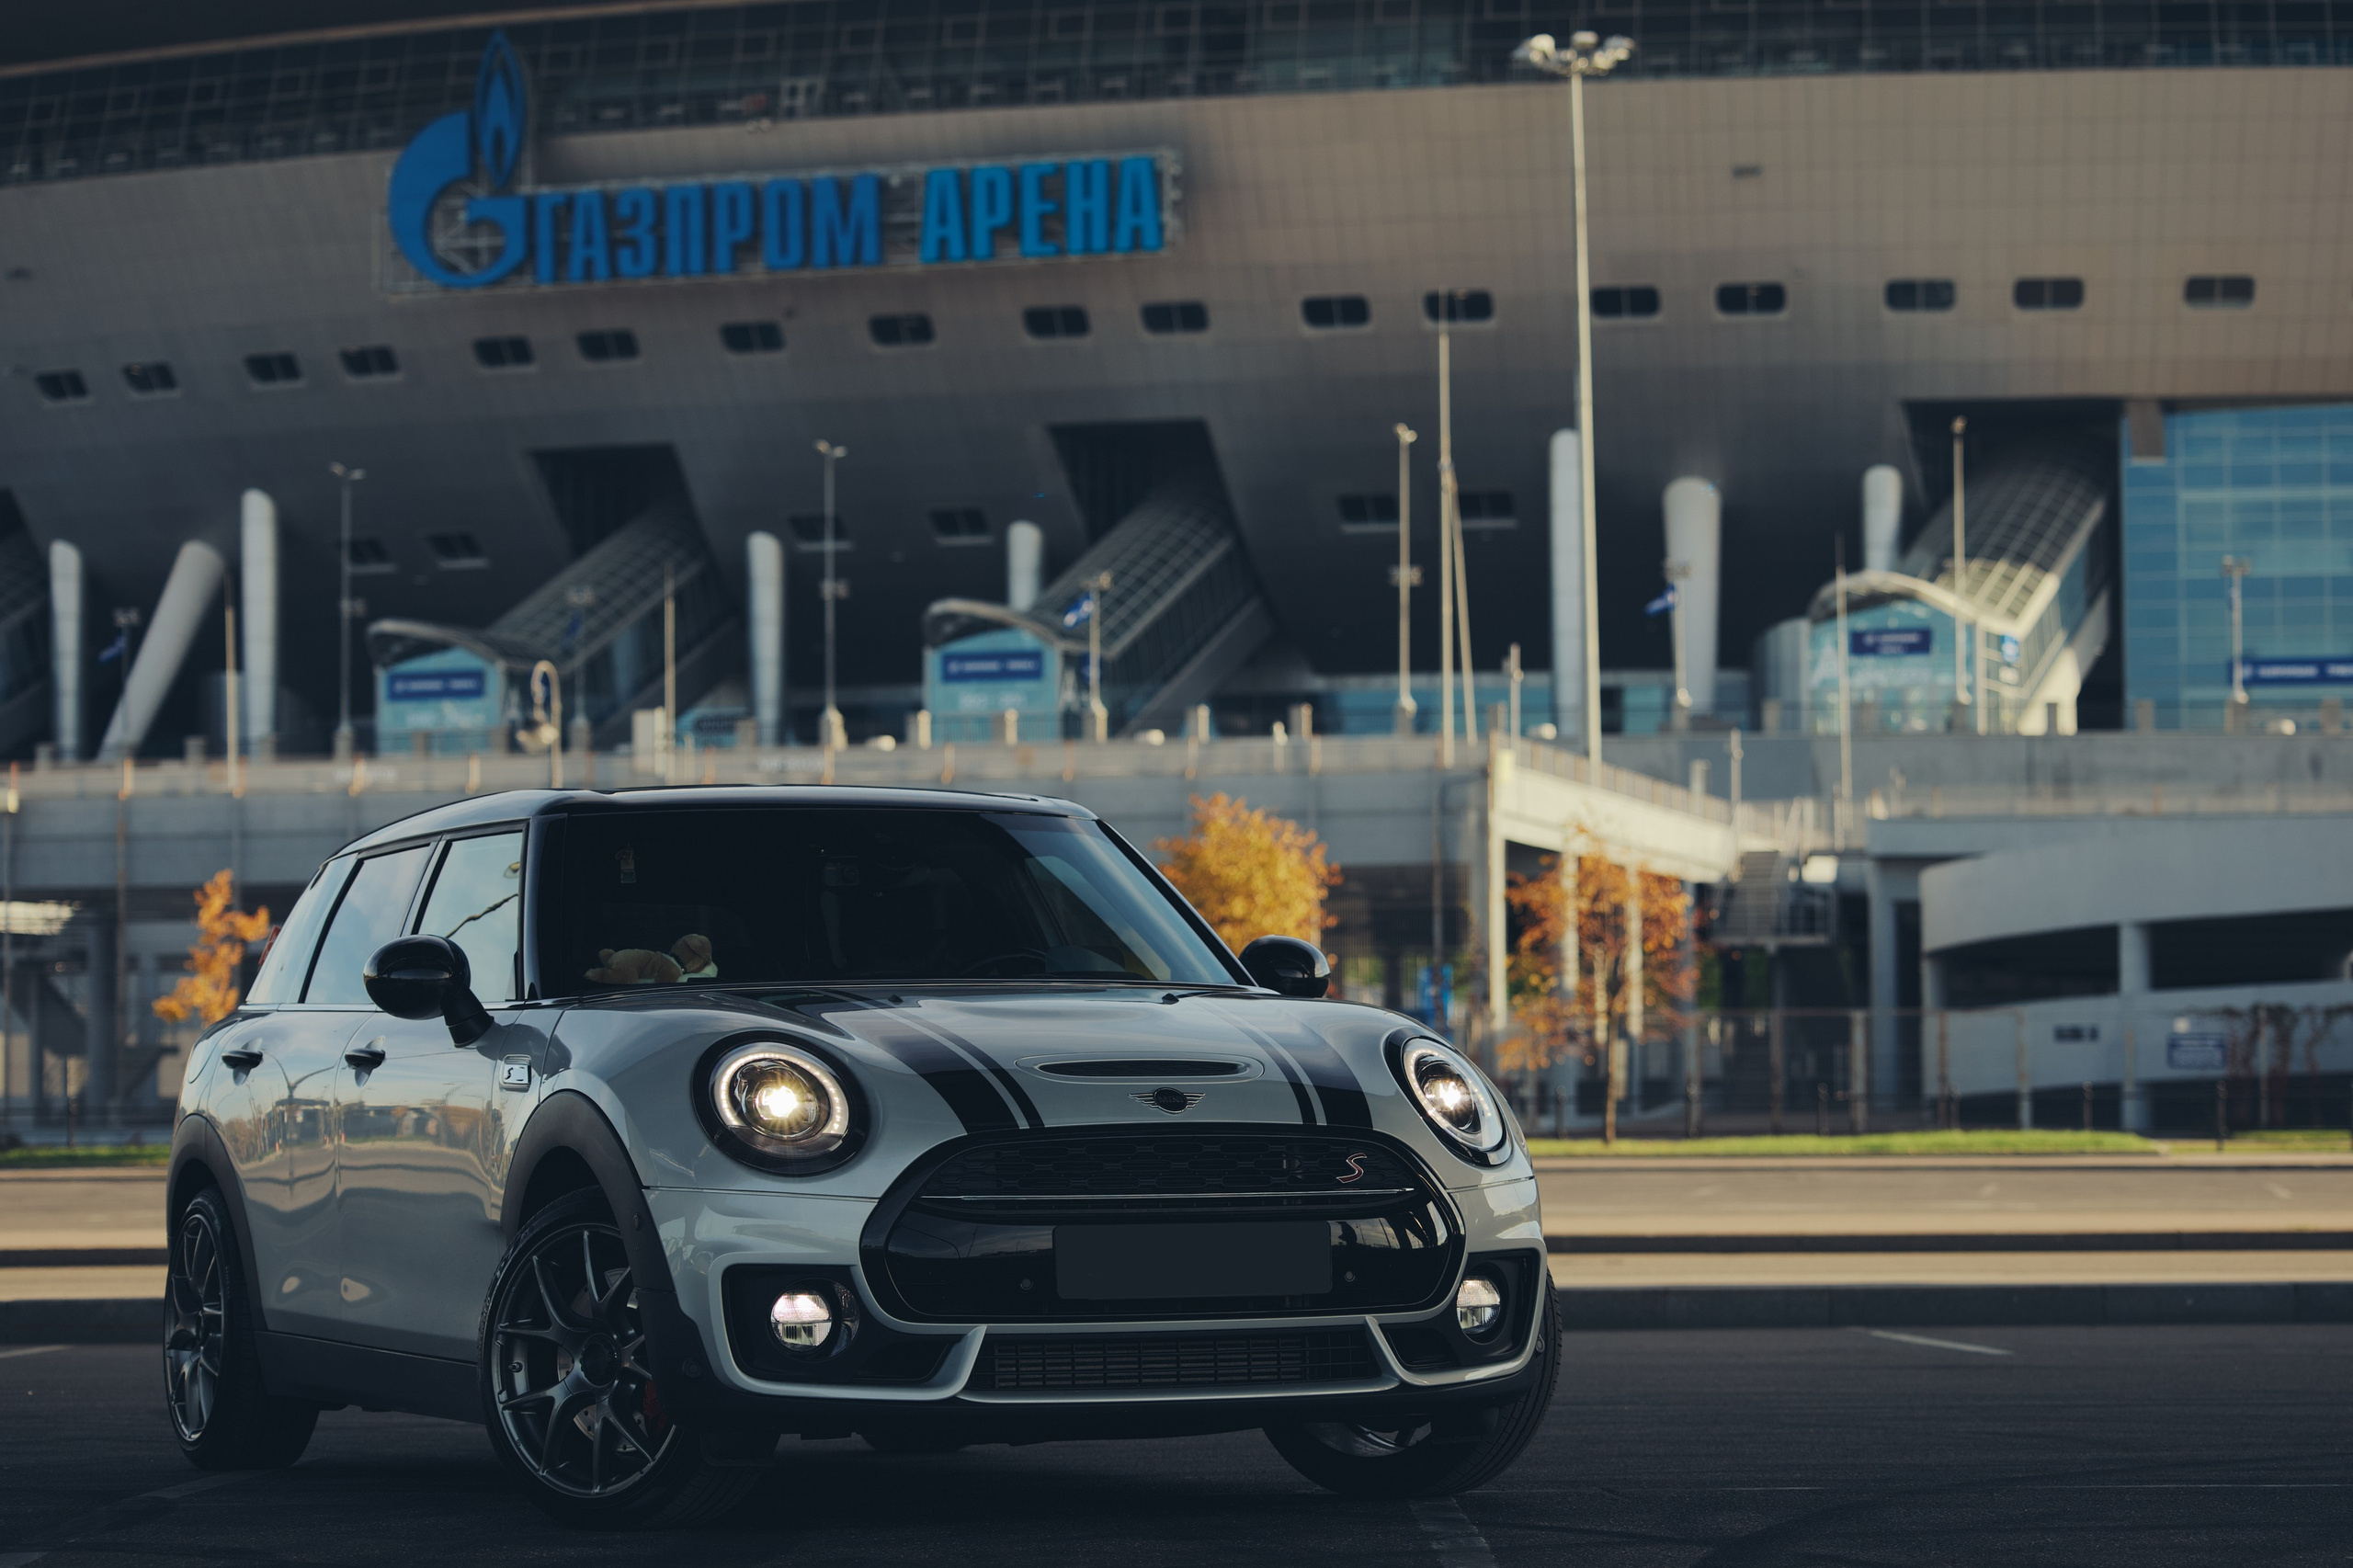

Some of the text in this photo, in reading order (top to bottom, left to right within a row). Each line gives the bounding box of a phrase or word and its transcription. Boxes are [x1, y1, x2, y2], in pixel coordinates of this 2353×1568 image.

[536, 156, 1163, 284] ГАЗПРОМ АРЕНА
[1157, 1095, 1184, 1103] MINI
[1336, 1152, 1367, 1184] S
